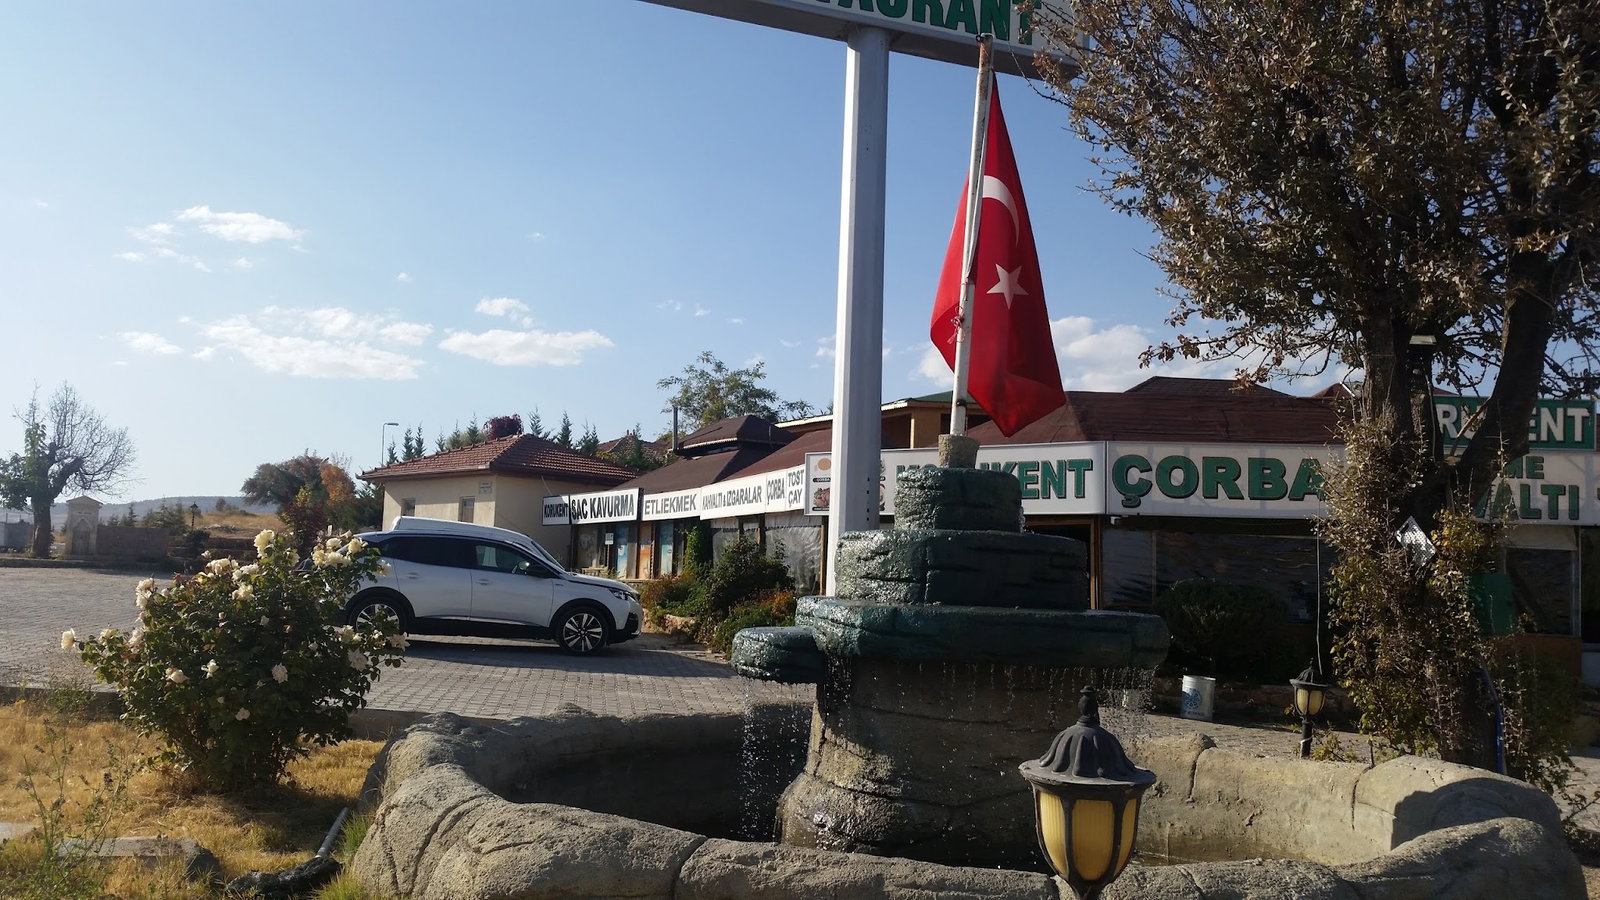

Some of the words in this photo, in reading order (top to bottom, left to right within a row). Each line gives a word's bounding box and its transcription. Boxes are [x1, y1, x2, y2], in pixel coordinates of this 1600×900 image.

[788, 469, 804, 487] TOST
[1112, 455, 1325, 507] ÇORBA
[571, 498, 588, 520] SAC
[590, 494, 635, 518] KAVURMA
[727, 486, 762, 507] IZGARALAR
[788, 488, 803, 507] ÇAY
